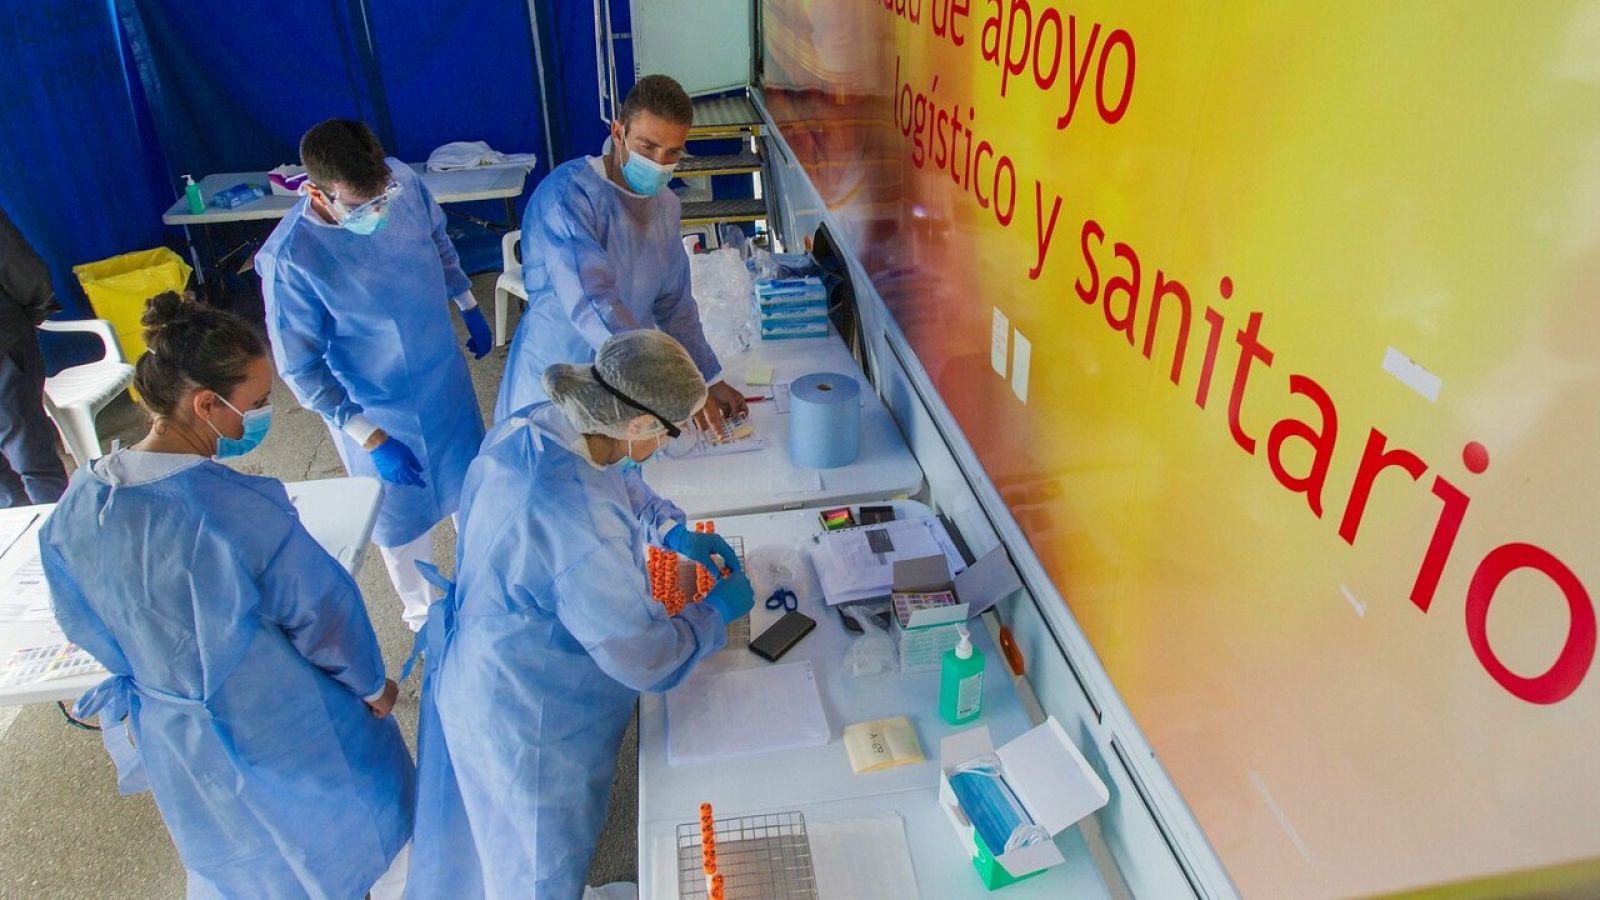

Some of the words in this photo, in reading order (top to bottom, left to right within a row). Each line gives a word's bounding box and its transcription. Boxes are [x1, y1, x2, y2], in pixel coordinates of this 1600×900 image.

[981, 0, 1136, 130] apoyo
[894, 55, 1016, 227] logístico
[1028, 180, 1063, 280] y
[1075, 219, 1597, 705] sanitario
